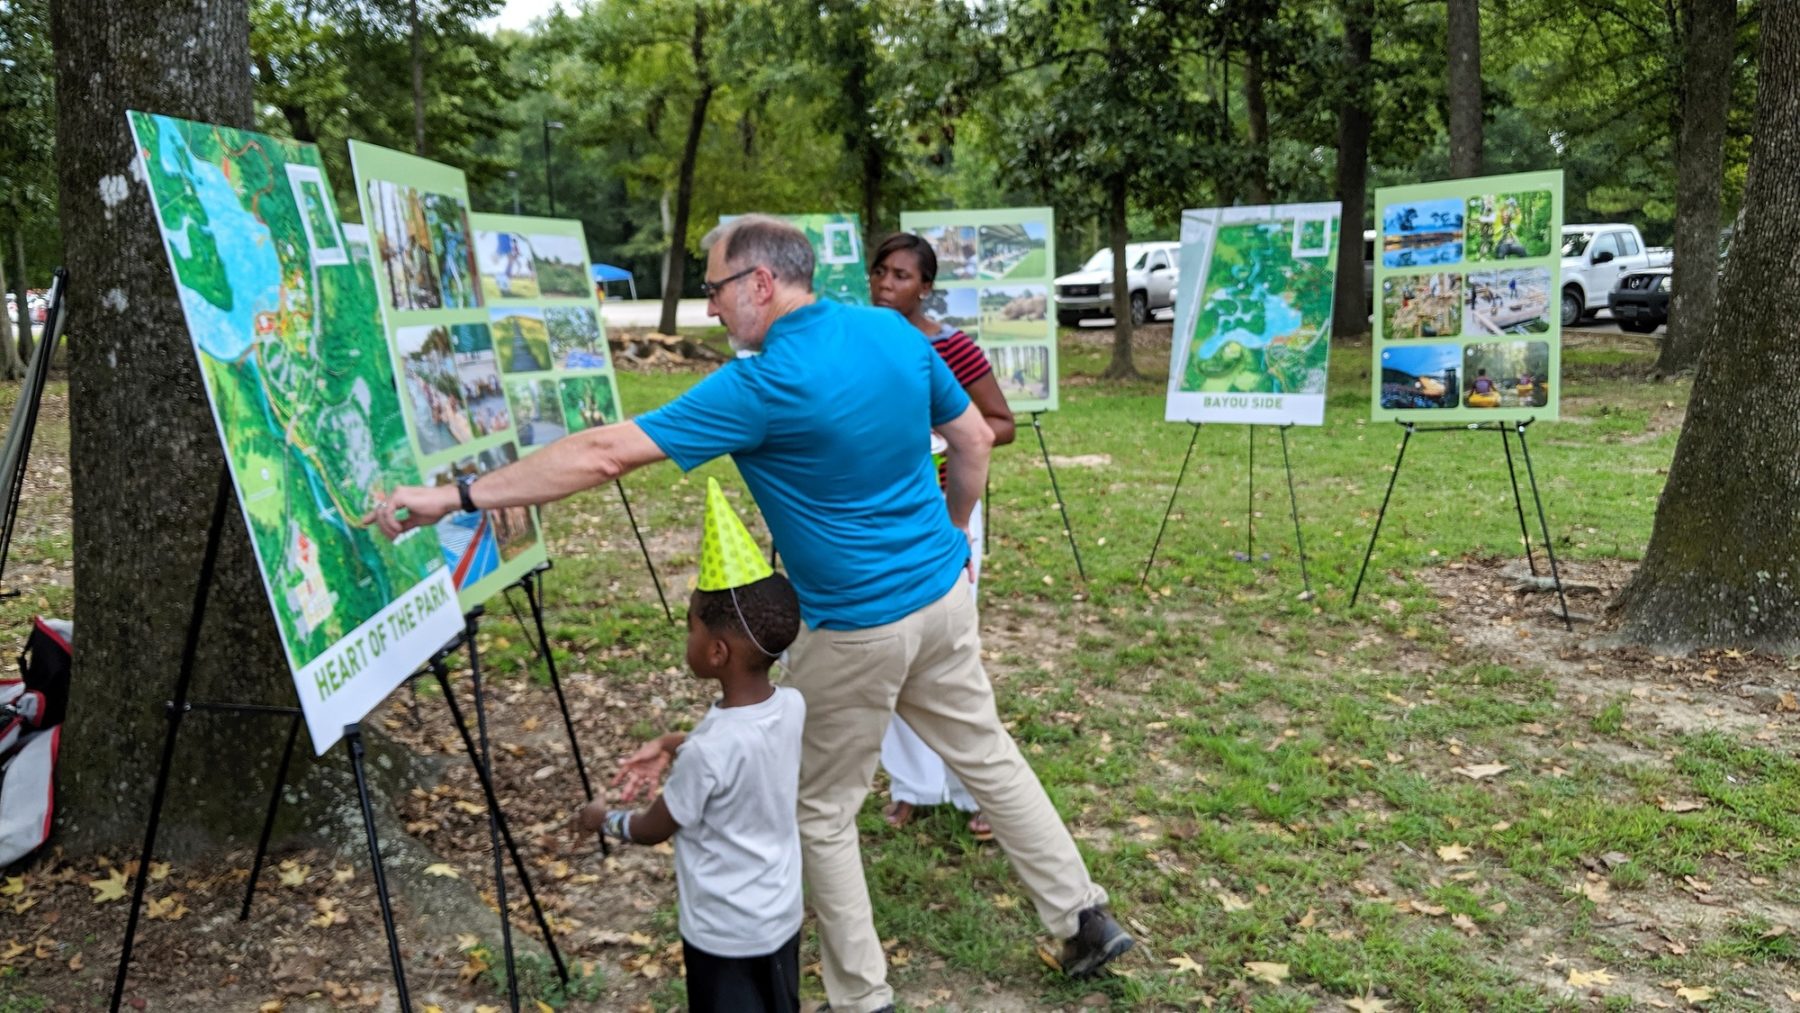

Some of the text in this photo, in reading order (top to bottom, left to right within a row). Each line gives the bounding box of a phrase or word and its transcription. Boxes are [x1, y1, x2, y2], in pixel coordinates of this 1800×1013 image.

[1203, 396, 1282, 409] BAYOU SIDE
[313, 578, 450, 702] HEART OF THE PARK
